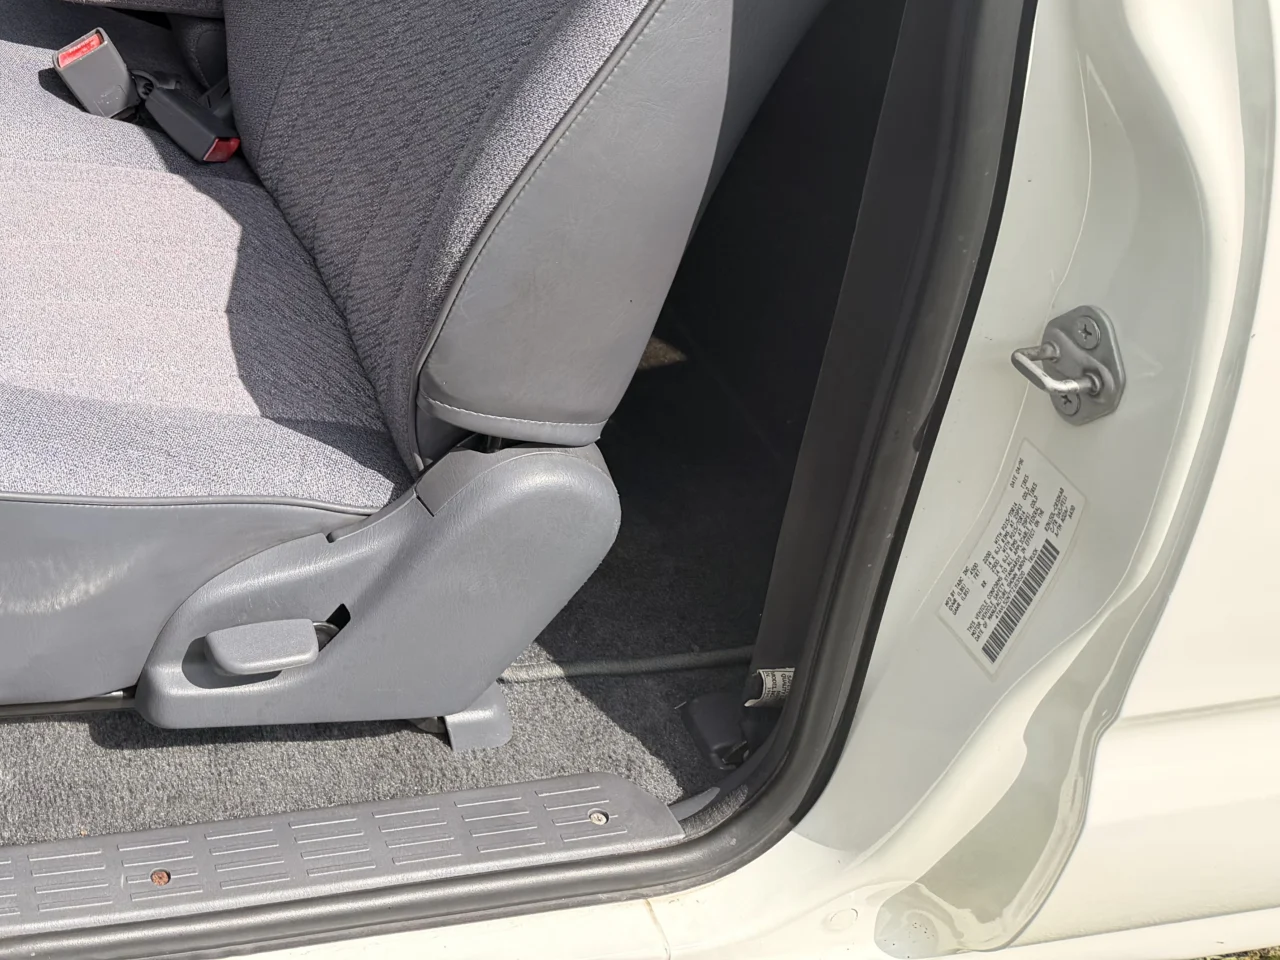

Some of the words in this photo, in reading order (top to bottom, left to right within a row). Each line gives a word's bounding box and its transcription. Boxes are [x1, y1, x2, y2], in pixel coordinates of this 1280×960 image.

[1009, 474, 1018, 489] DATE
[1021, 473, 1029, 490] TIRES
[1029, 481, 1038, 498] TIRES
[975, 600, 988, 620] VEHICLE
[981, 601, 994, 622] VEHICLE
